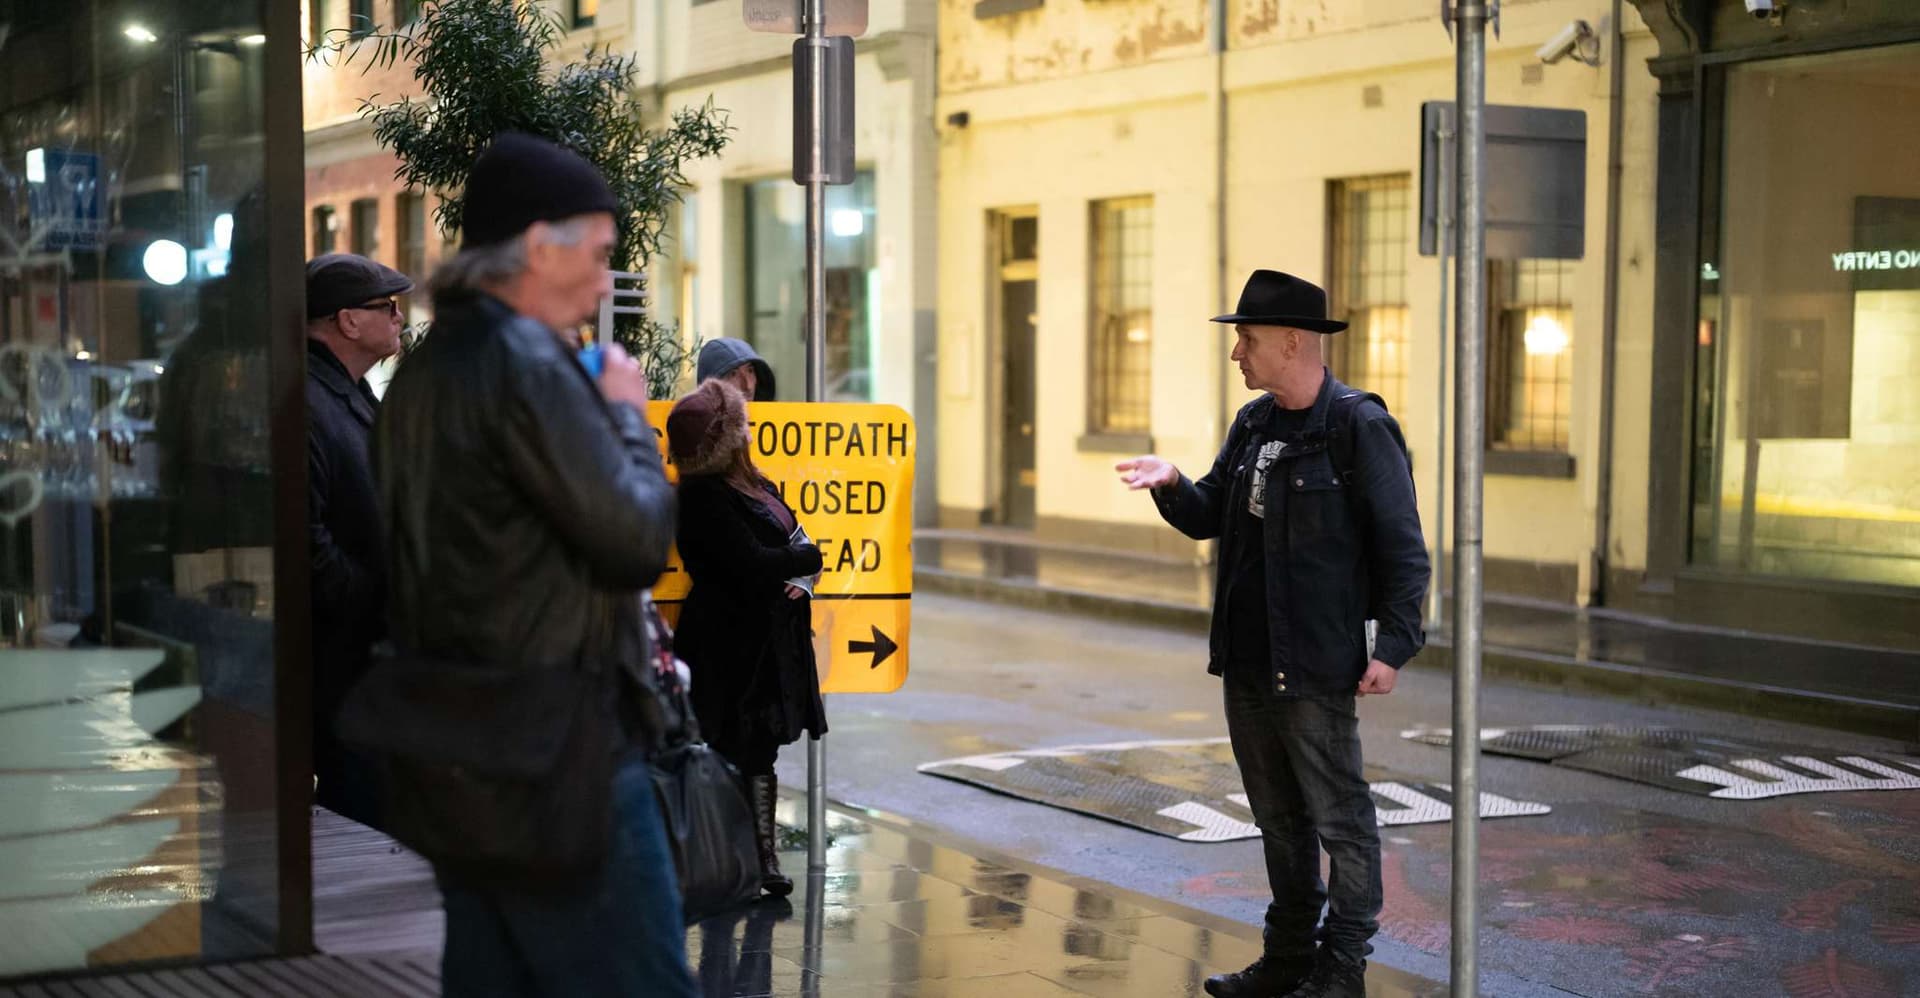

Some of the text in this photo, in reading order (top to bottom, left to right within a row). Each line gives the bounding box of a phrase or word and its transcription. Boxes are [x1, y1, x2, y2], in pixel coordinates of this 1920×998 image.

[750, 421, 907, 457] OOTPATH
[781, 480, 885, 514] LOSED
[817, 539, 881, 572] EAD
